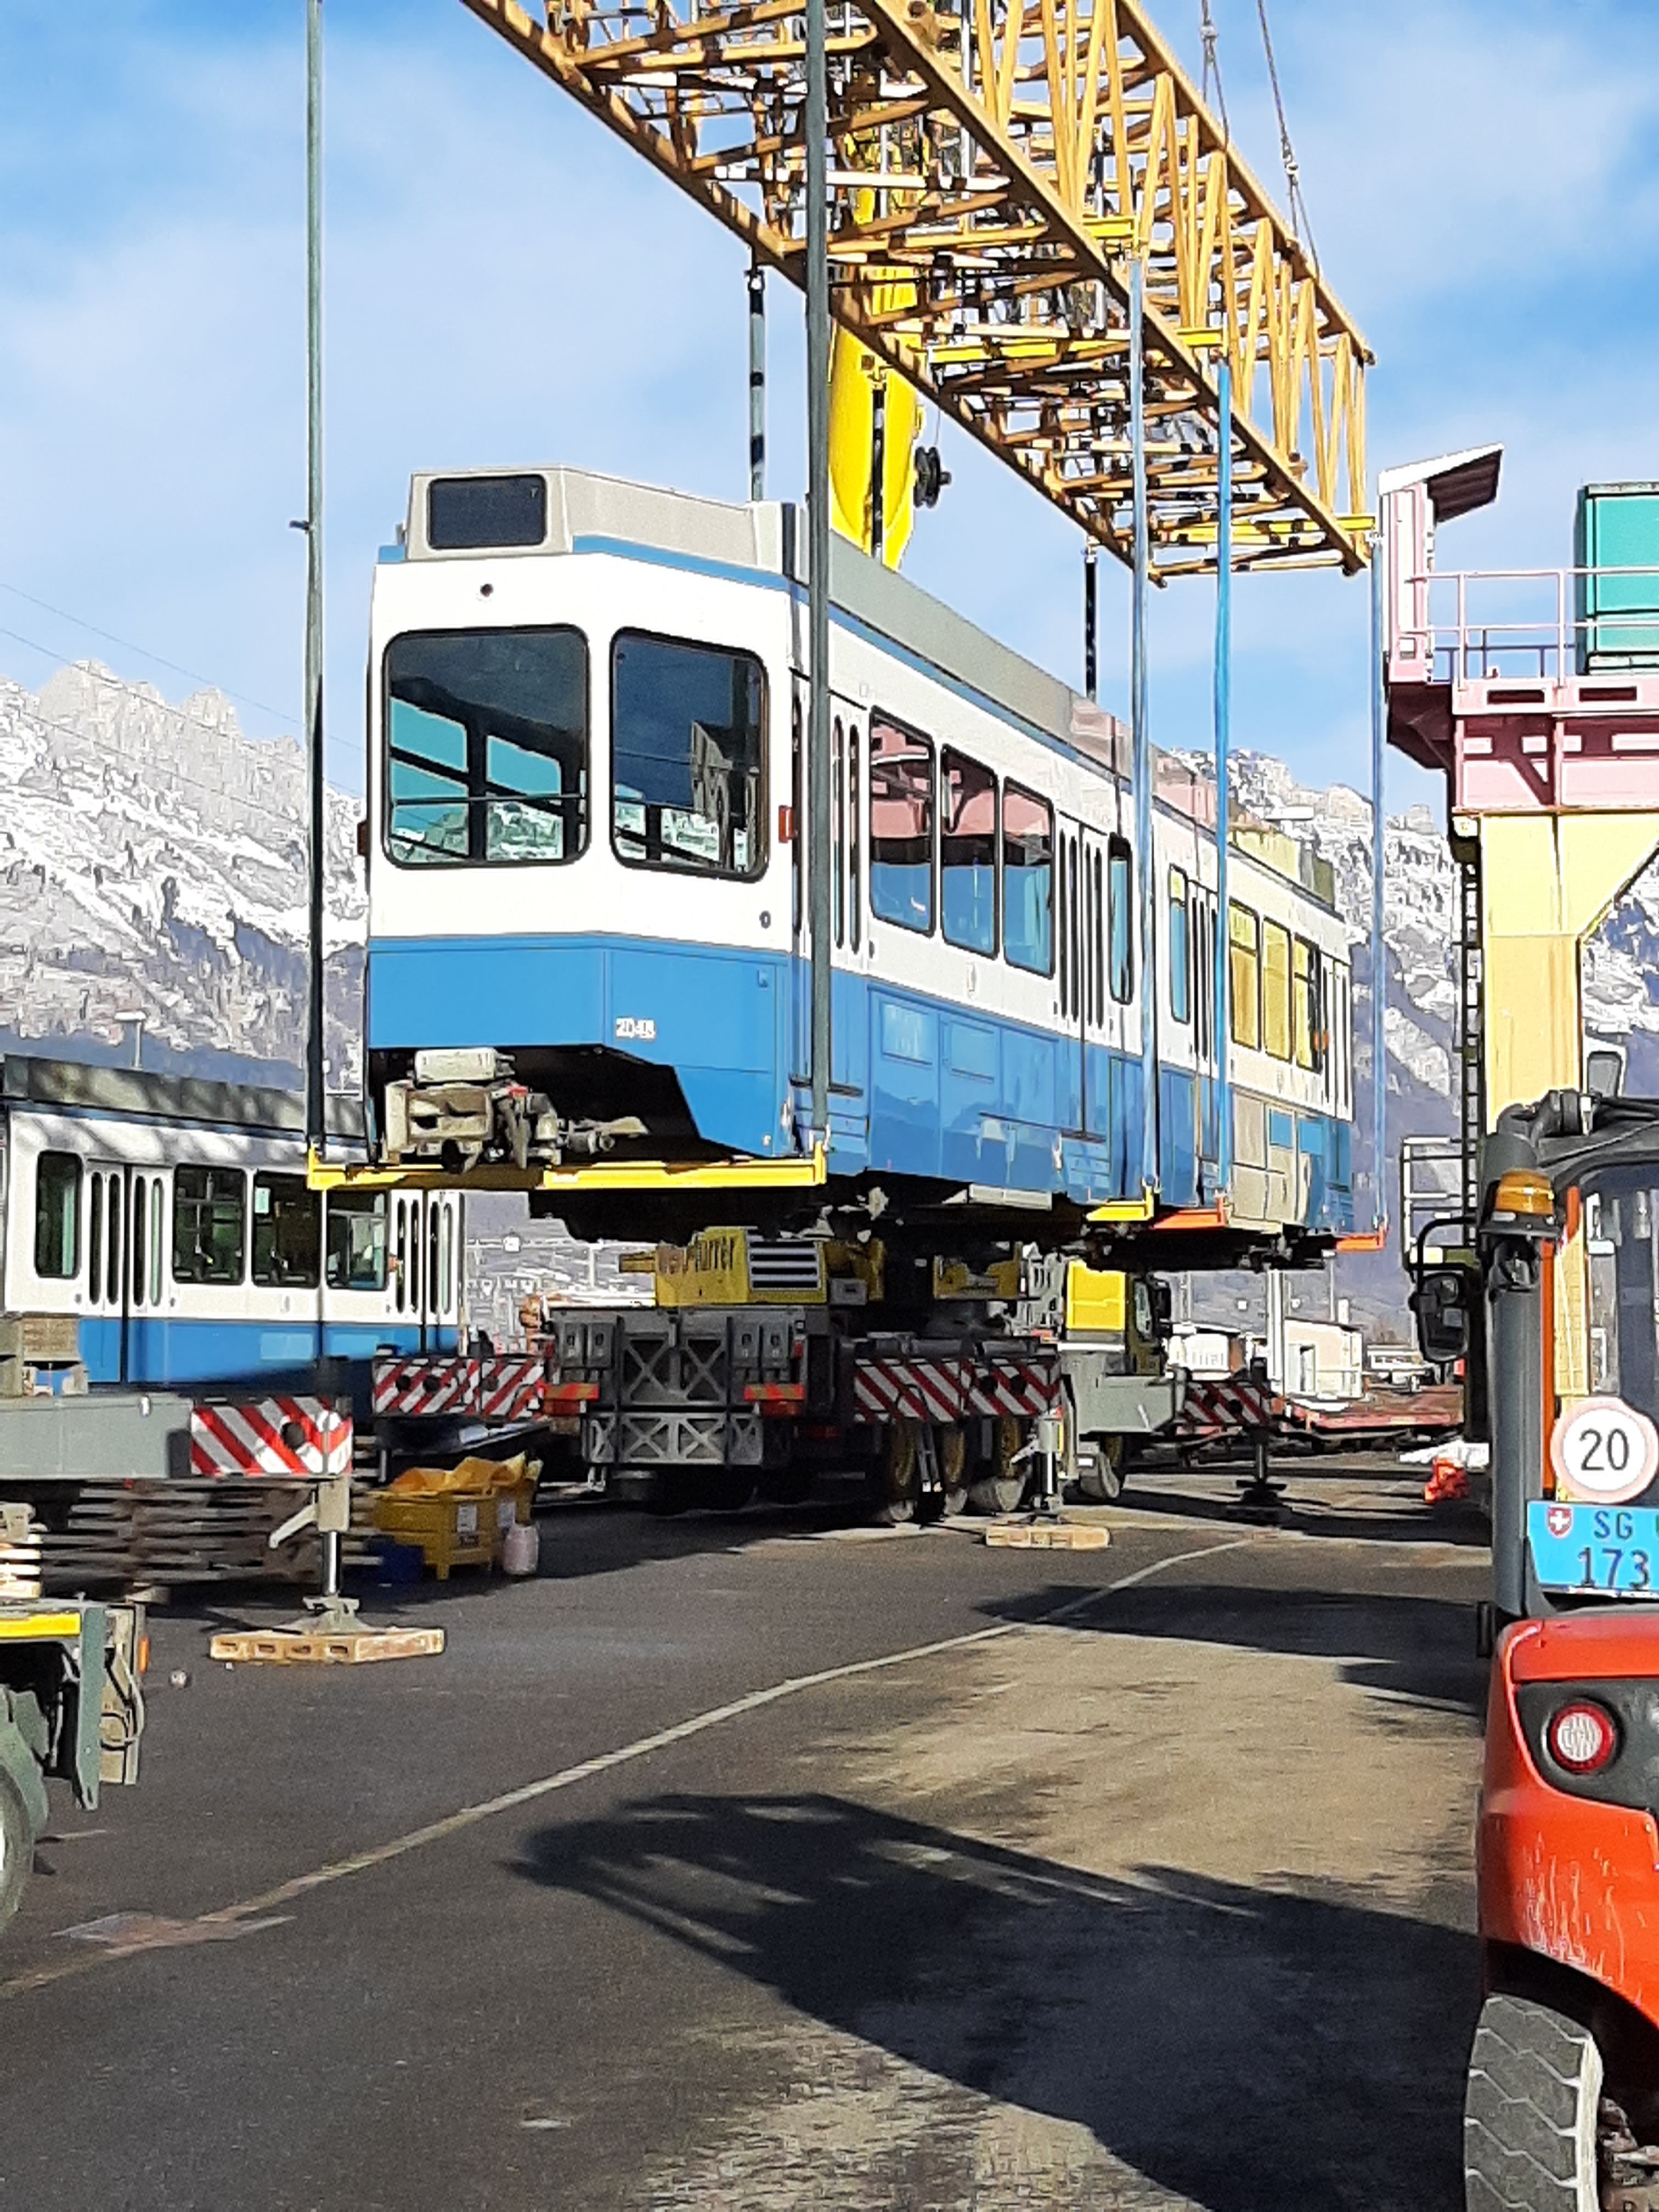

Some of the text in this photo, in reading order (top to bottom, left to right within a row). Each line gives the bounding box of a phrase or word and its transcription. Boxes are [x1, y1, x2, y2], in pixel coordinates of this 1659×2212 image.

[1578, 1427, 1630, 1471] 20
[1594, 1510, 1634, 1541] SG
[1577, 1546, 1650, 1591] 173
